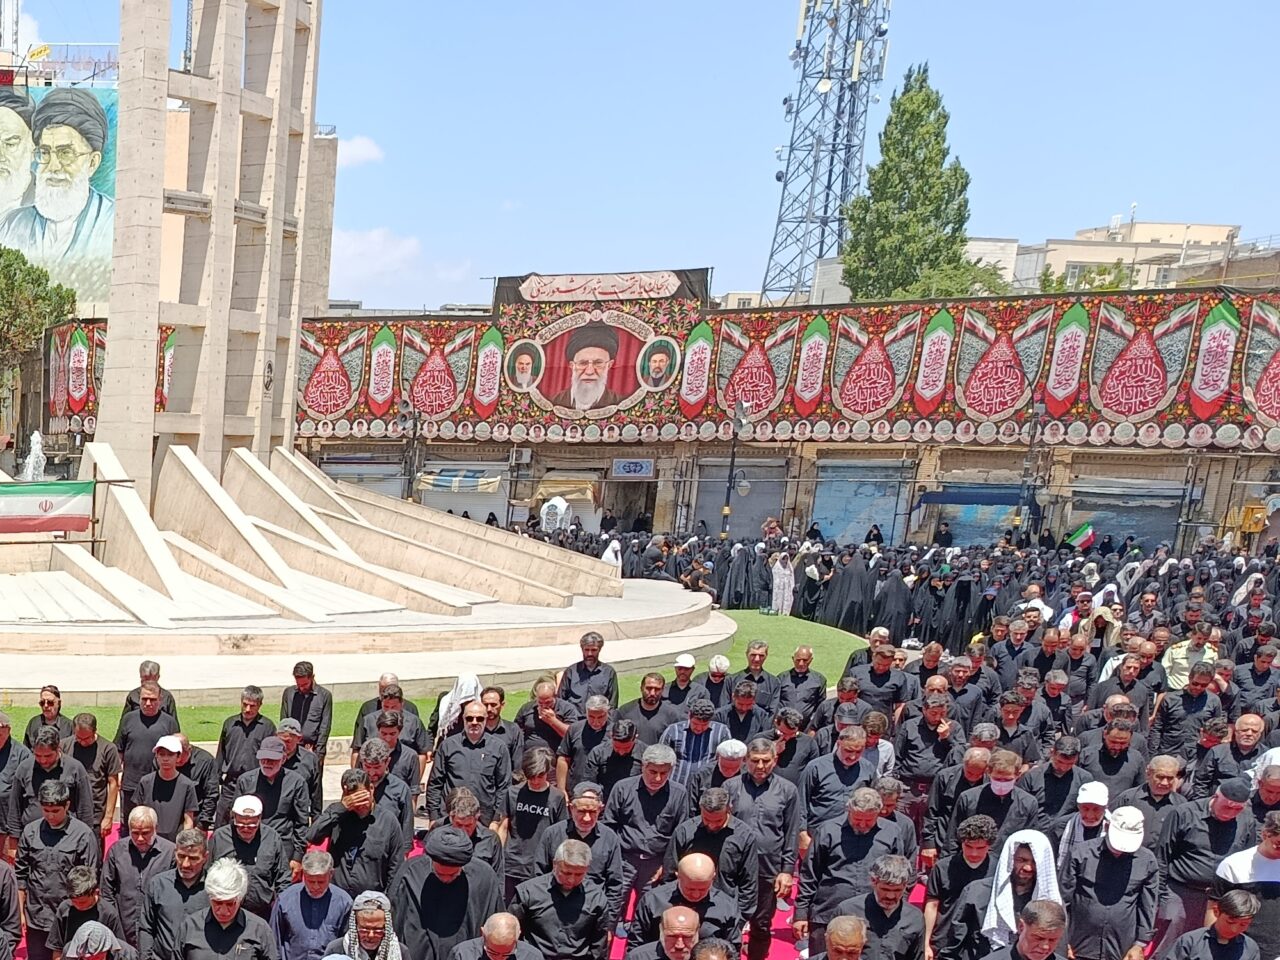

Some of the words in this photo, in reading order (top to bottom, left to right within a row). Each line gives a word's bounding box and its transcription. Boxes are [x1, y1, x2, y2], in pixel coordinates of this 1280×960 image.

[530, 277, 556, 299] حسینی
[546, 277, 594, 297] شعور
[598, 276, 644, 295] پایتخت
[644, 274, 671, 294] زنجان
[516, 802, 549, 816] BACK&
